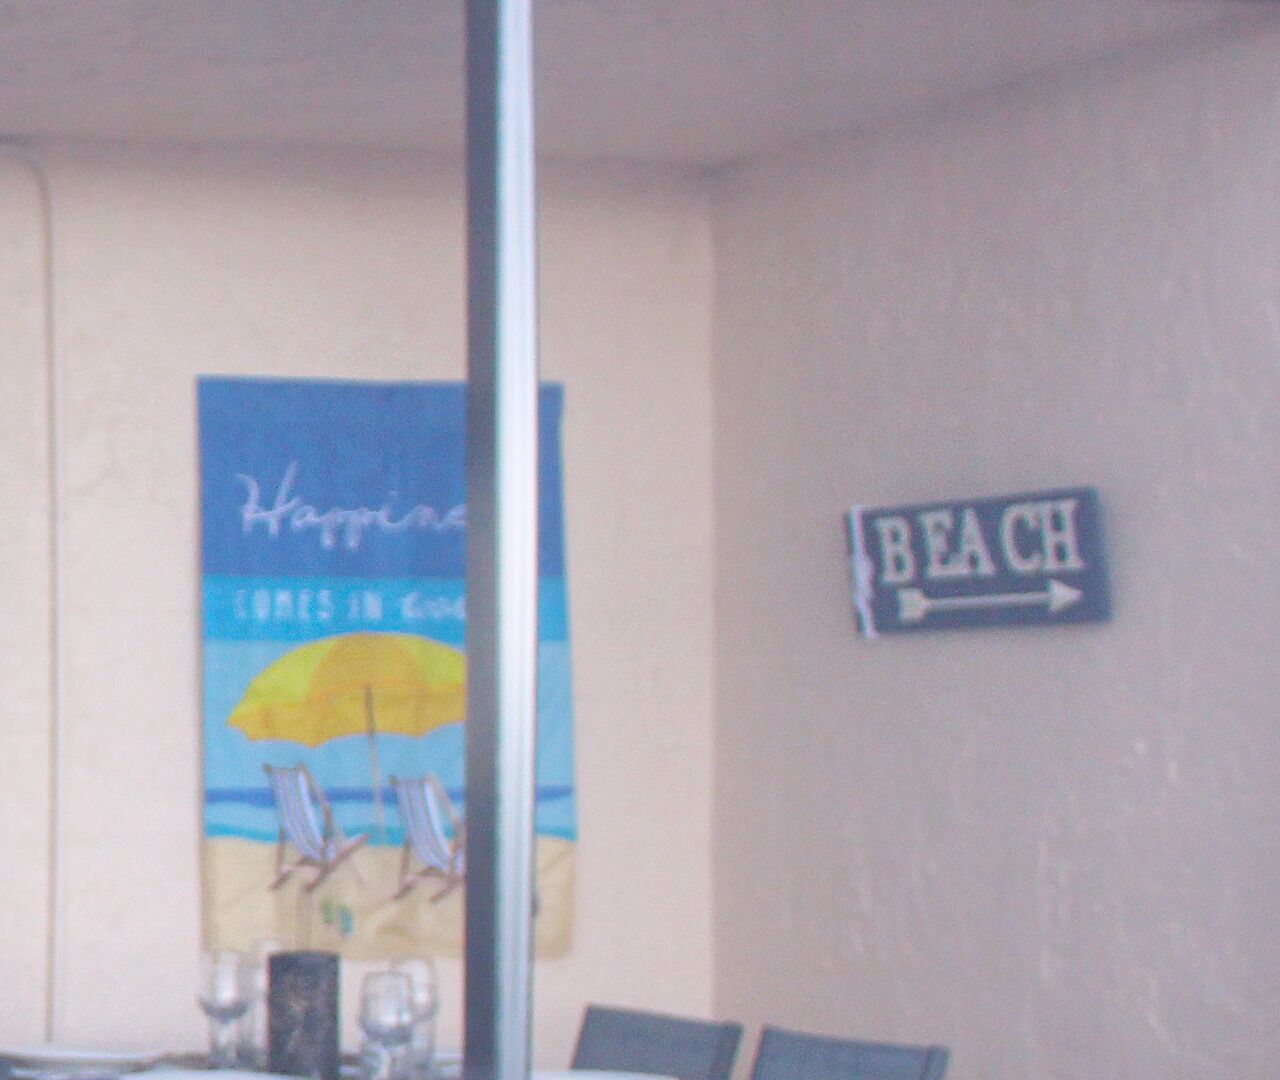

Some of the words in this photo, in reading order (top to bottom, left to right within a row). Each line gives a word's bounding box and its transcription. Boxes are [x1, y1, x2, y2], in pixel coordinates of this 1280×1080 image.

[874, 499, 1086, 584] BEACH
[234, 589, 333, 621] COMES
[348, 590, 383, 621] IN
